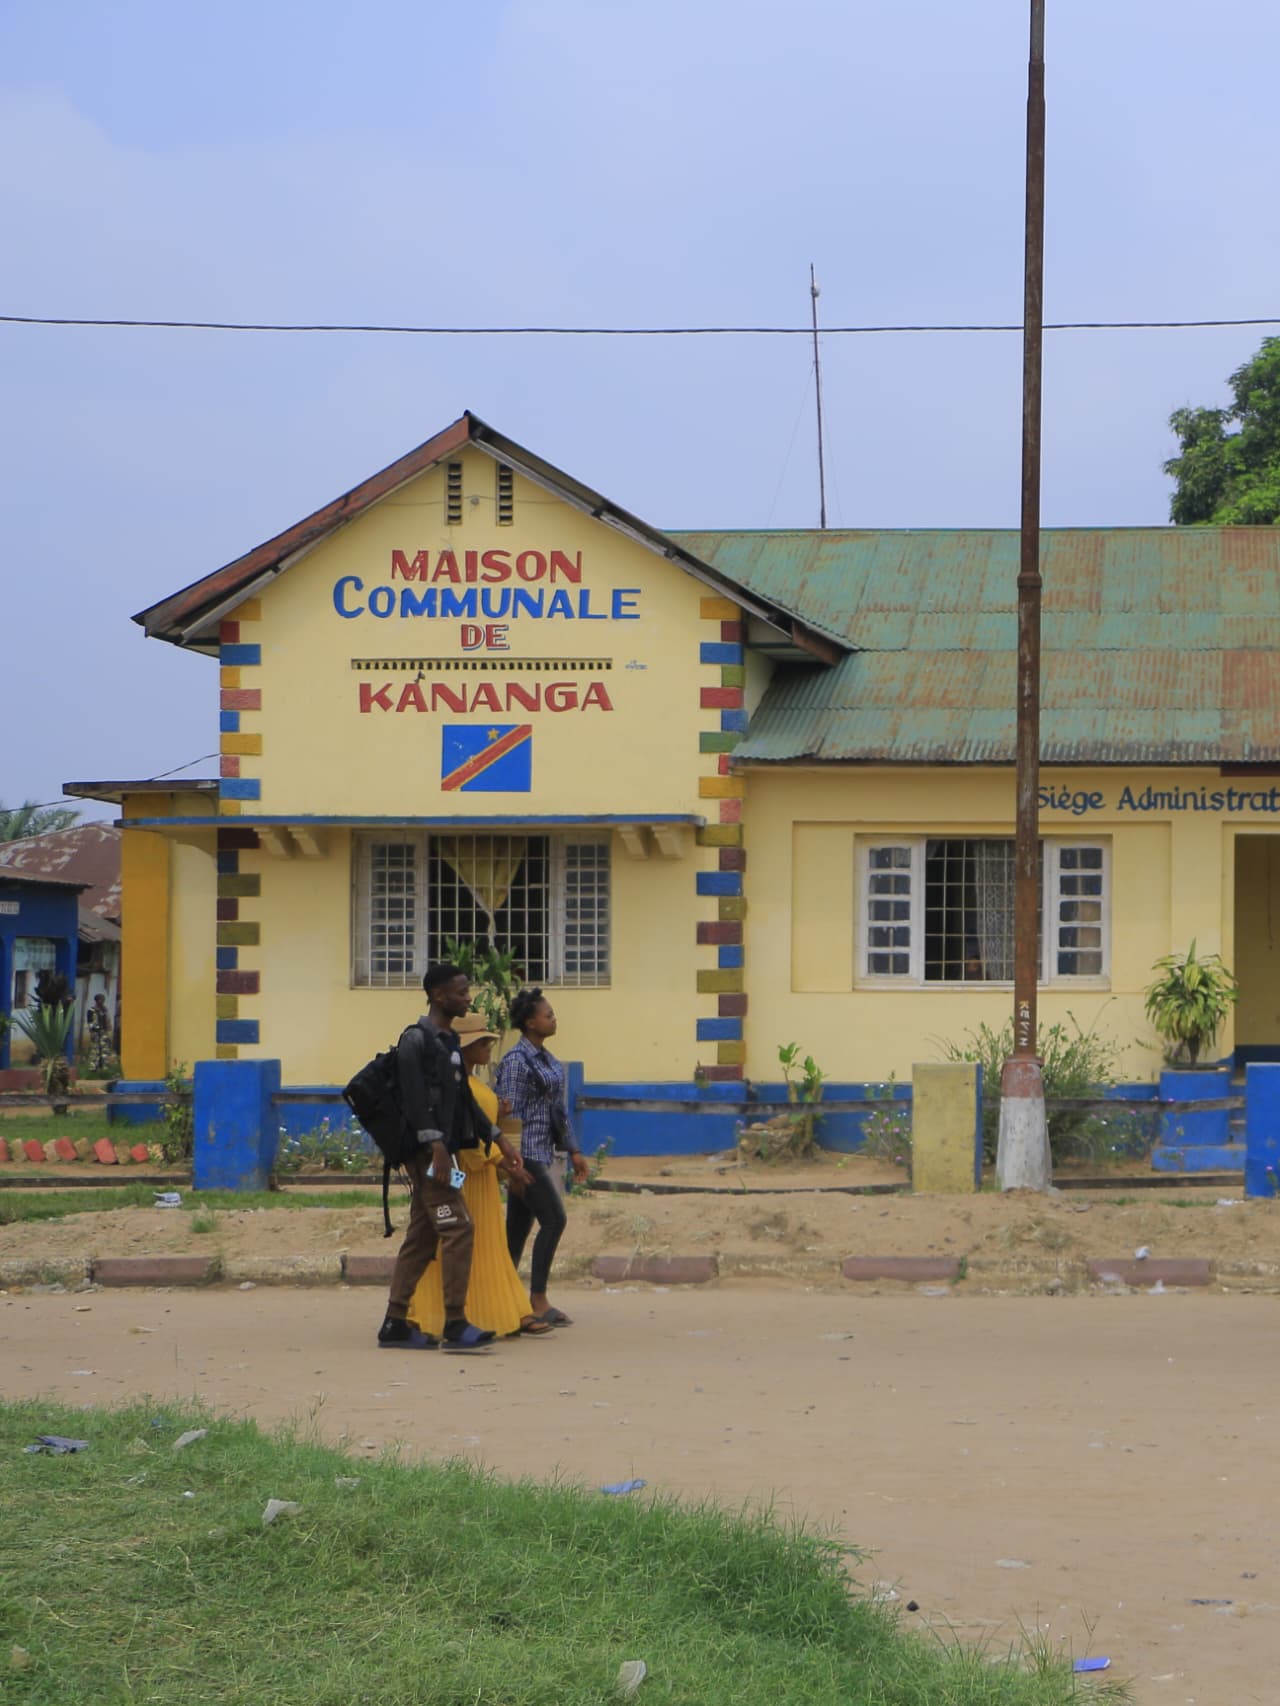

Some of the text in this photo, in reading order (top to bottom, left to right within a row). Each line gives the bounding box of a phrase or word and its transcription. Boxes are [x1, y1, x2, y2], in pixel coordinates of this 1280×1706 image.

[391, 549, 582, 583] MAISON
[333, 575, 641, 619] COMMUNALE
[460, 623, 509, 651] DE
[359, 681, 614, 713] KANANGA
[1037, 784, 1105, 816] Siège
